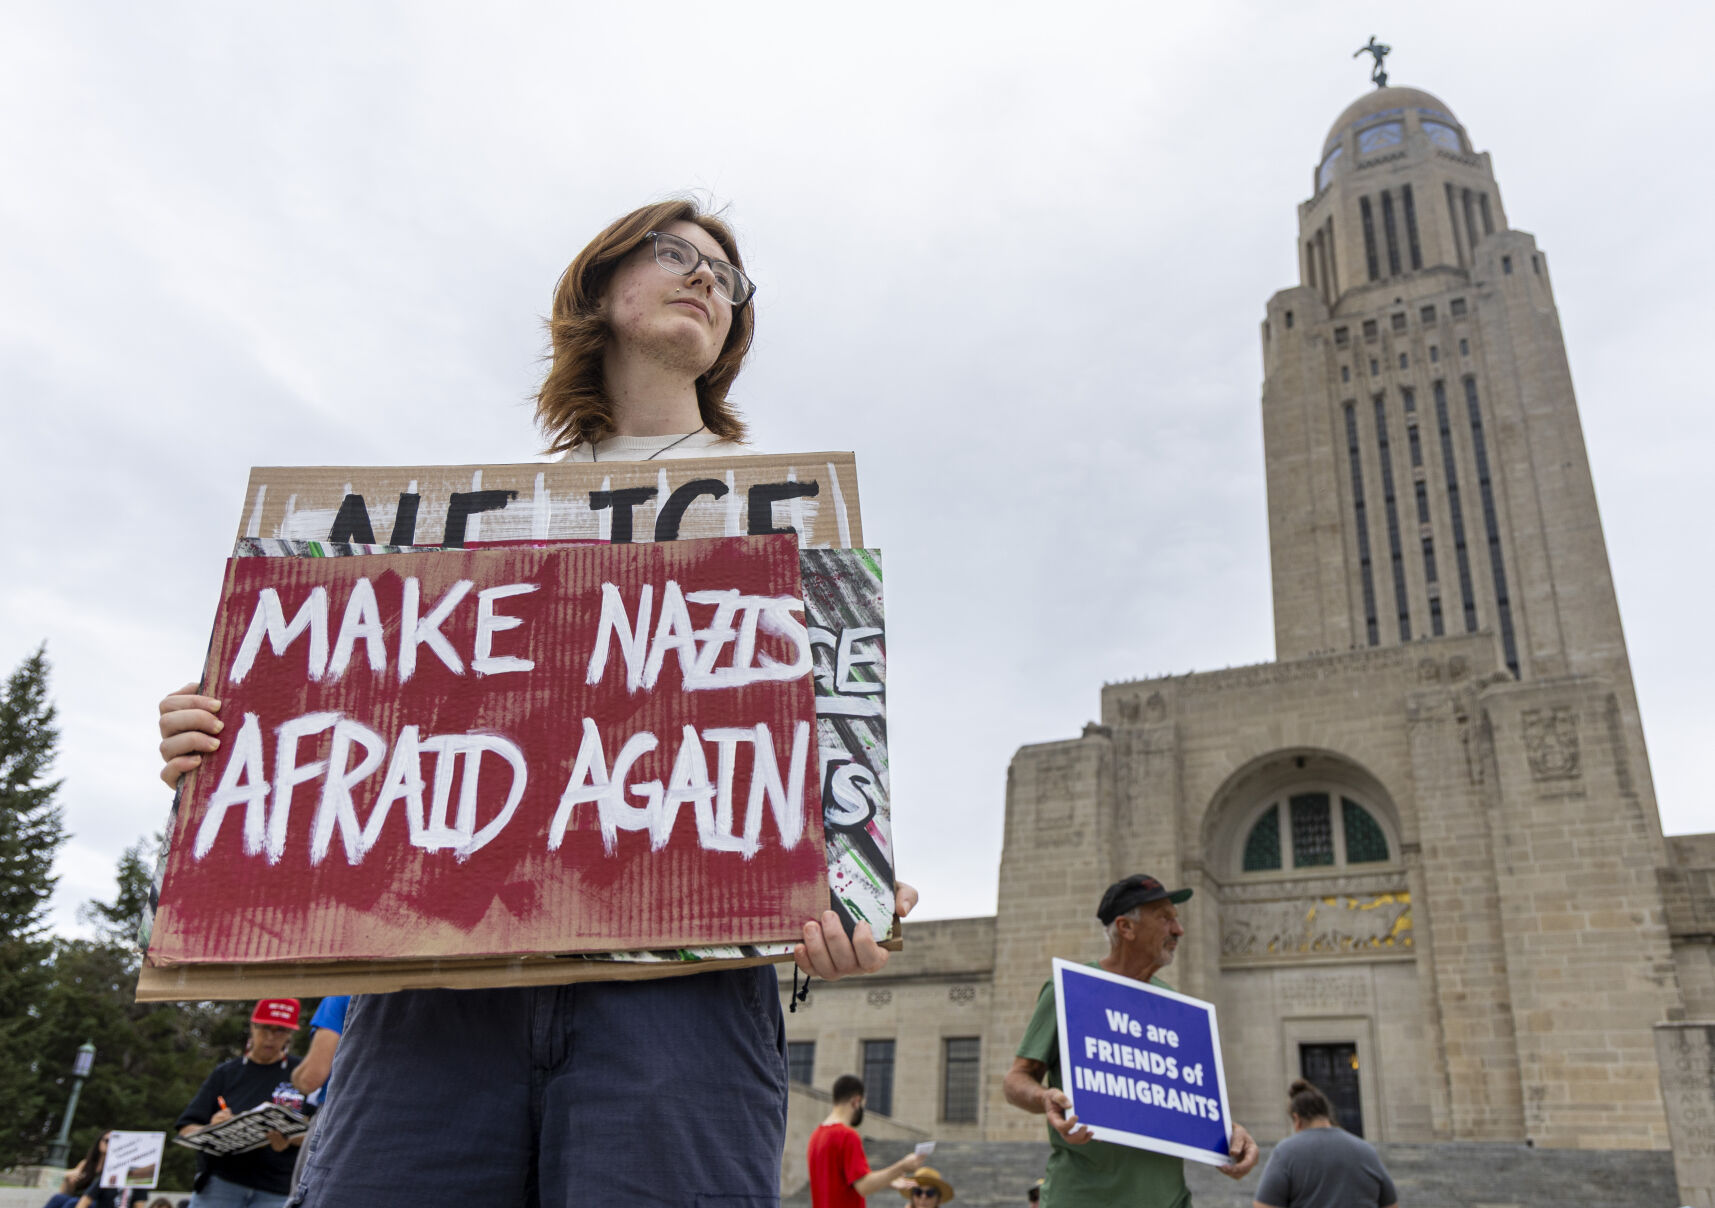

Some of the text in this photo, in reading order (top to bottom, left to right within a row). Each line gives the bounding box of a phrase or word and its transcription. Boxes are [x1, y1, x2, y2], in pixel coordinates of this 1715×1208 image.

[229, 577, 815, 694] MAKE NAZIS
[194, 712, 811, 866] AFRAID AGAIN
[1105, 1008, 1179, 1048] We are
[1084, 1036, 1204, 1087] FRIENDS of
[1074, 1066, 1220, 1122] IMMIGRANTS
